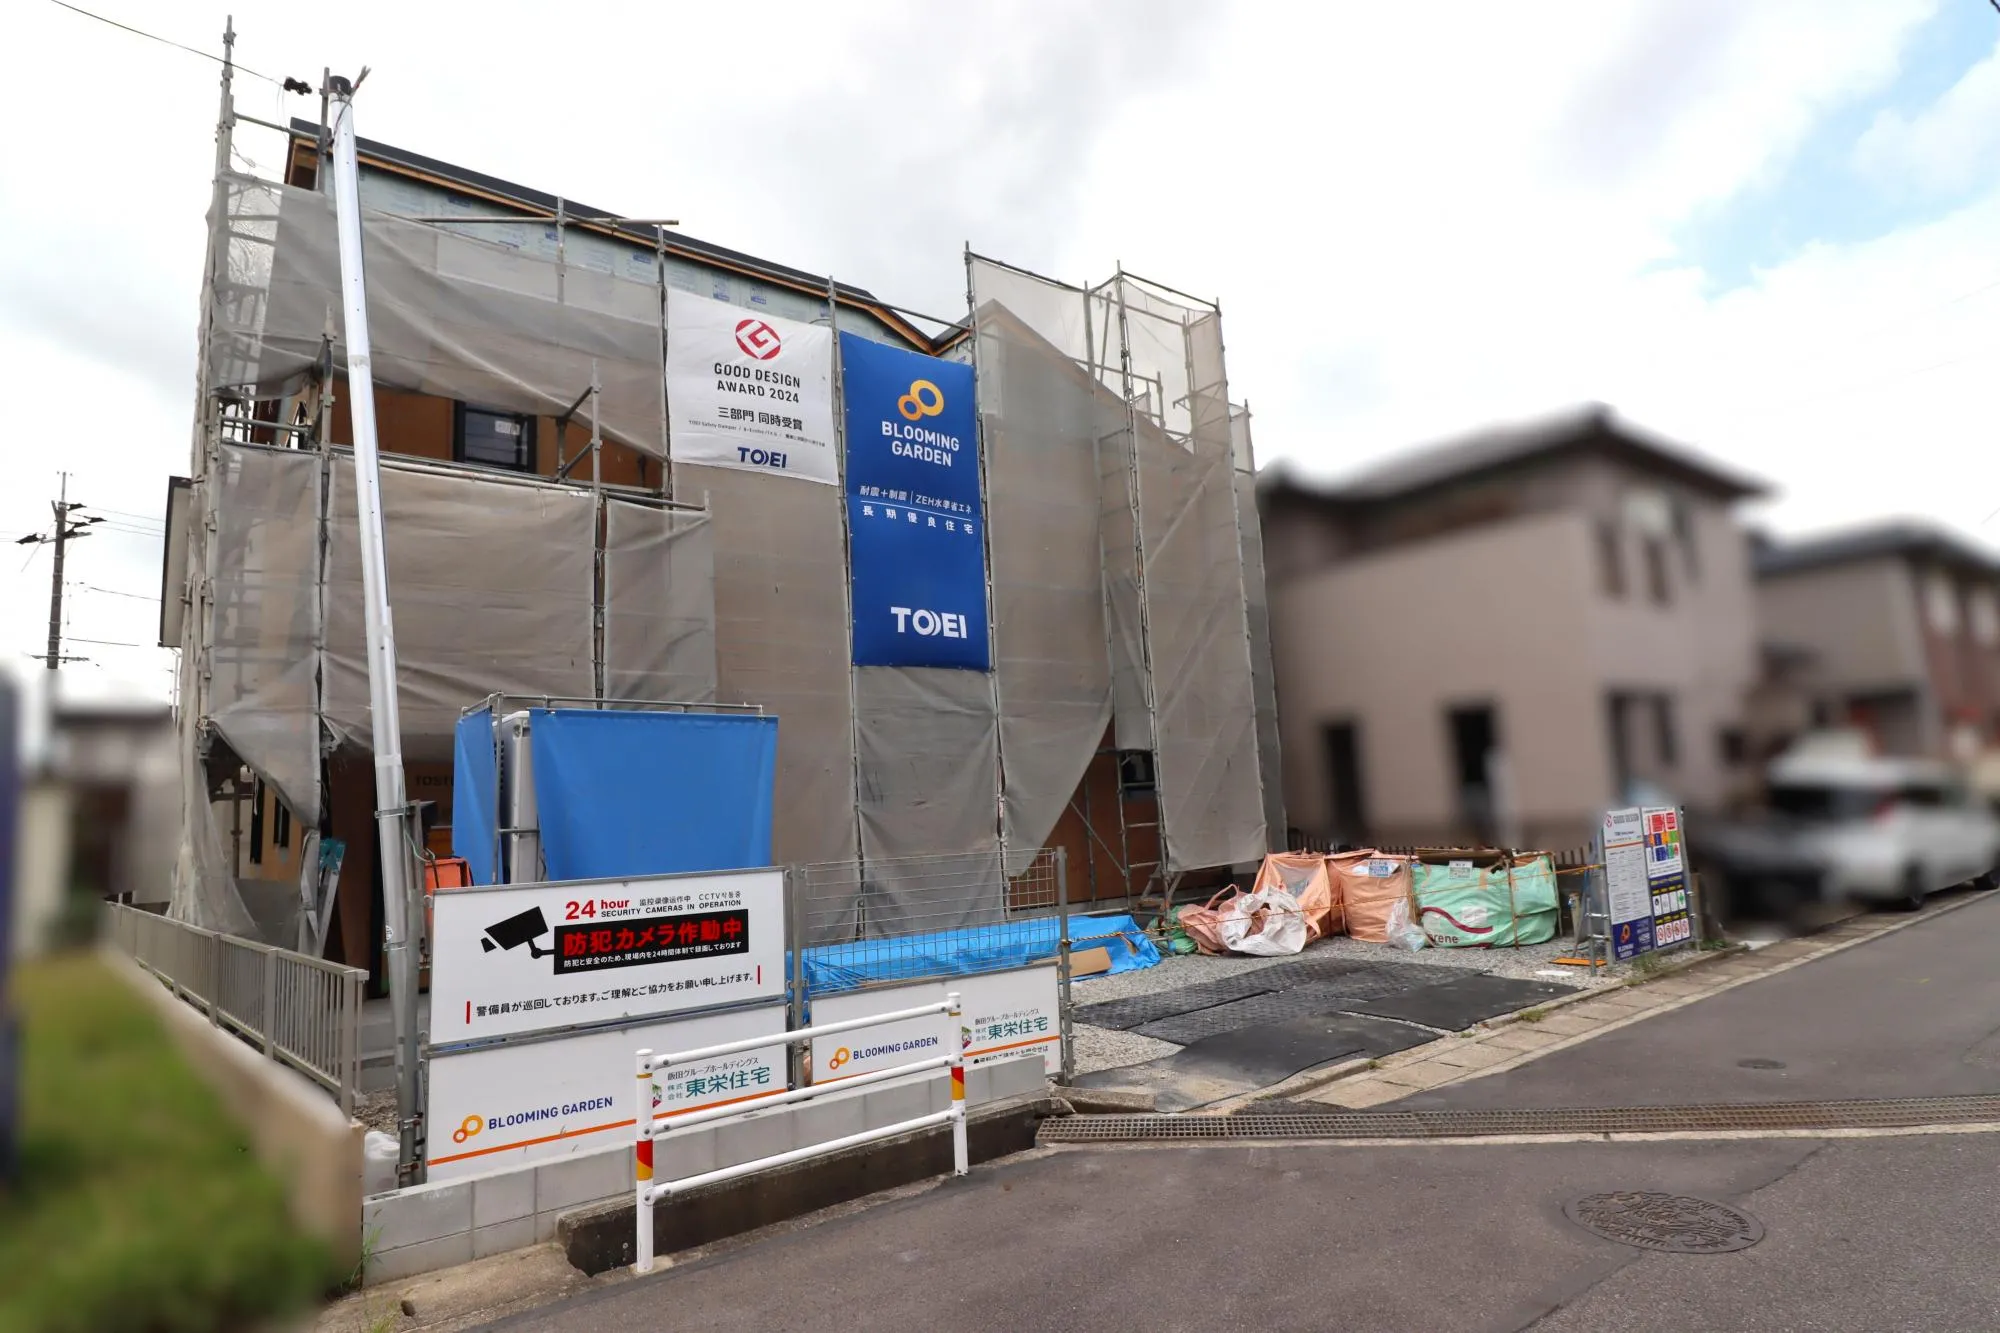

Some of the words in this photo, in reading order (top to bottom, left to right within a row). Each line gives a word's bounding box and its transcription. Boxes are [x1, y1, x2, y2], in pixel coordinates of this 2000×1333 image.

[714, 362, 751, 378] GOOD
[755, 369, 800, 388] DESIGN
[717, 380, 765, 396] AWARD
[769, 388, 799, 403] 2024
[718, 406, 754, 422] 三部門
[758, 411, 802, 431] 同時受賞
[881, 420, 960, 451] BLOOMING
[891, 441, 952, 467] GARDEN
[565, 899, 596, 920] 24
[600, 898, 630, 910] hour
[601, 908, 641, 918] SECURITY
[645, 904, 683, 914] CAMERAS
[699, 899, 741, 909] OPERATION
[563, 915, 742, 957] 防犯カメラ作動中
[988, 1016, 1048, 1040] 東栄住宅
[853, 1043, 901, 1060] BLOOMING
[902, 1036, 938, 1051] GARDEN
[667, 1057, 759, 1081] 飯田グループホールディングス
[685, 1066, 770, 1098] 東栄住宅
[488, 1107, 559, 1130] BLOOMING
[562, 1096, 613, 1116] GARDEN
